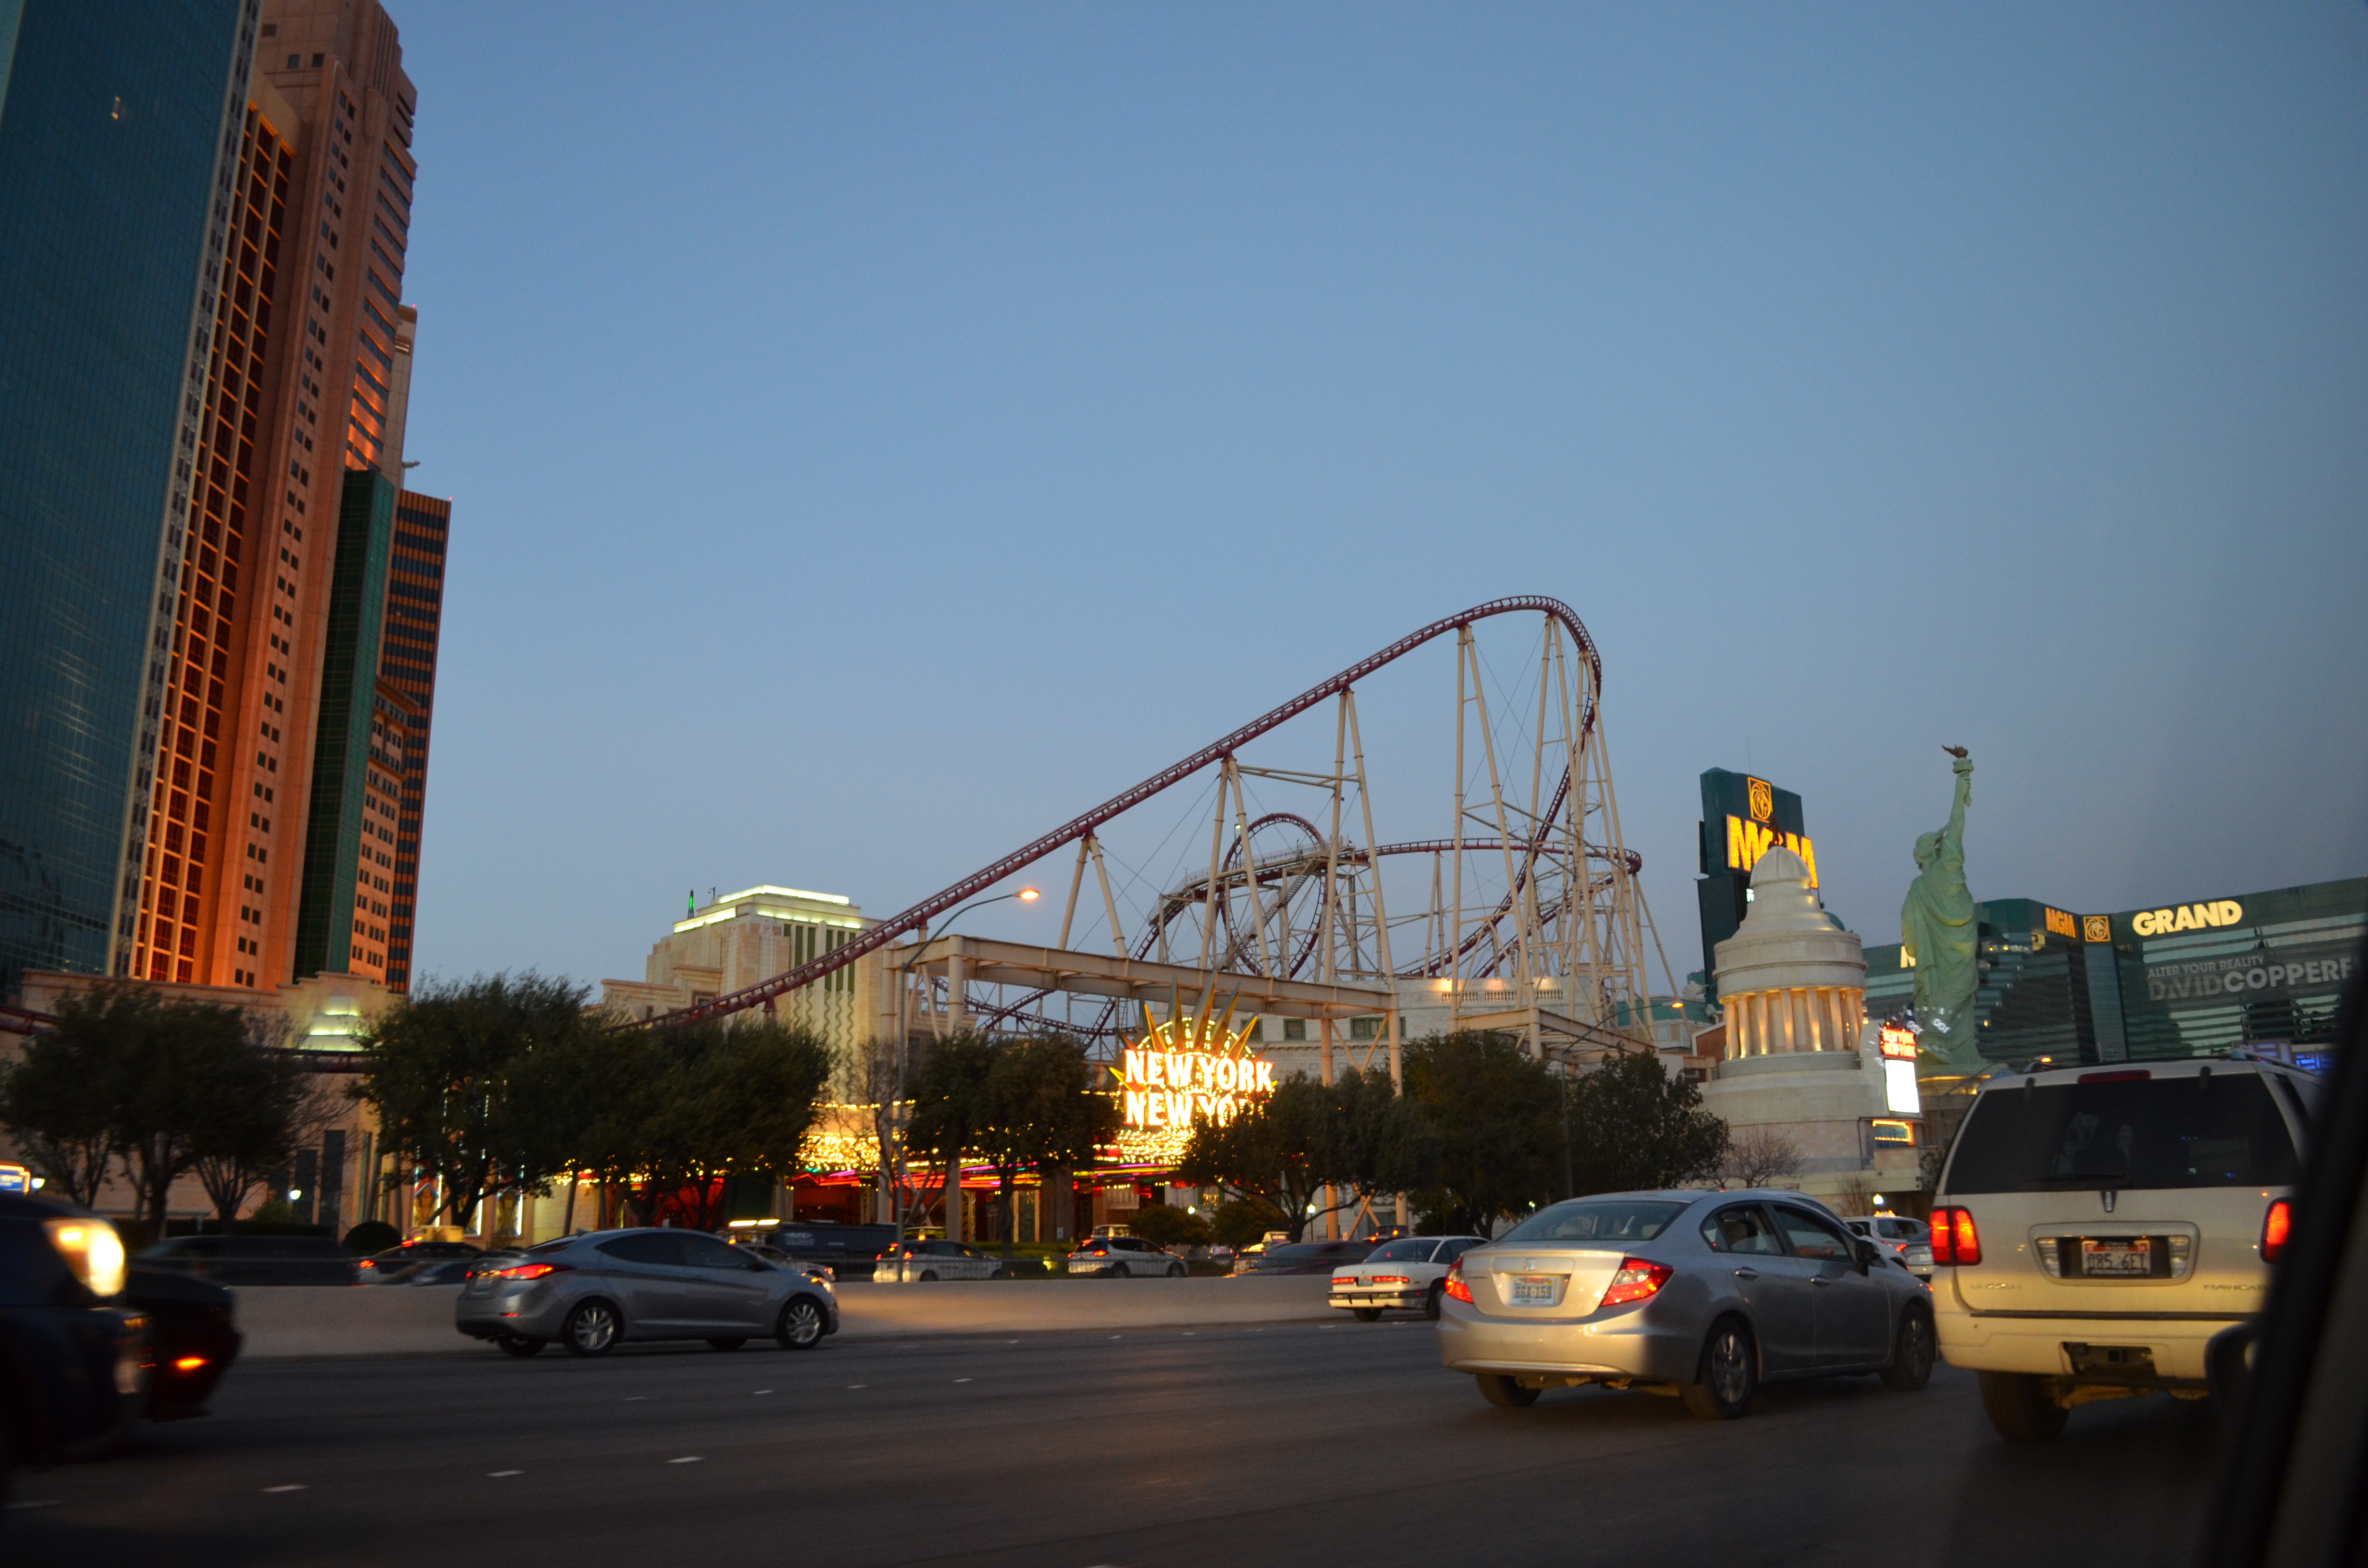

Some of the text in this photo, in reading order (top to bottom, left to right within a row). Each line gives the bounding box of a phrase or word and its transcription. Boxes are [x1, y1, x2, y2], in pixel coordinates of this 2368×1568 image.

[2045, 907, 2076, 938] MGM
[2132, 900, 2243, 936] GRAND
[2148, 955, 2265, 978] ALTER YOUR REALITY
[2223, 956, 2354, 993] COPPERF
[1124, 1049, 1274, 1092] NEW YORK
[1124, 1090, 1266, 1128] NEW YO
